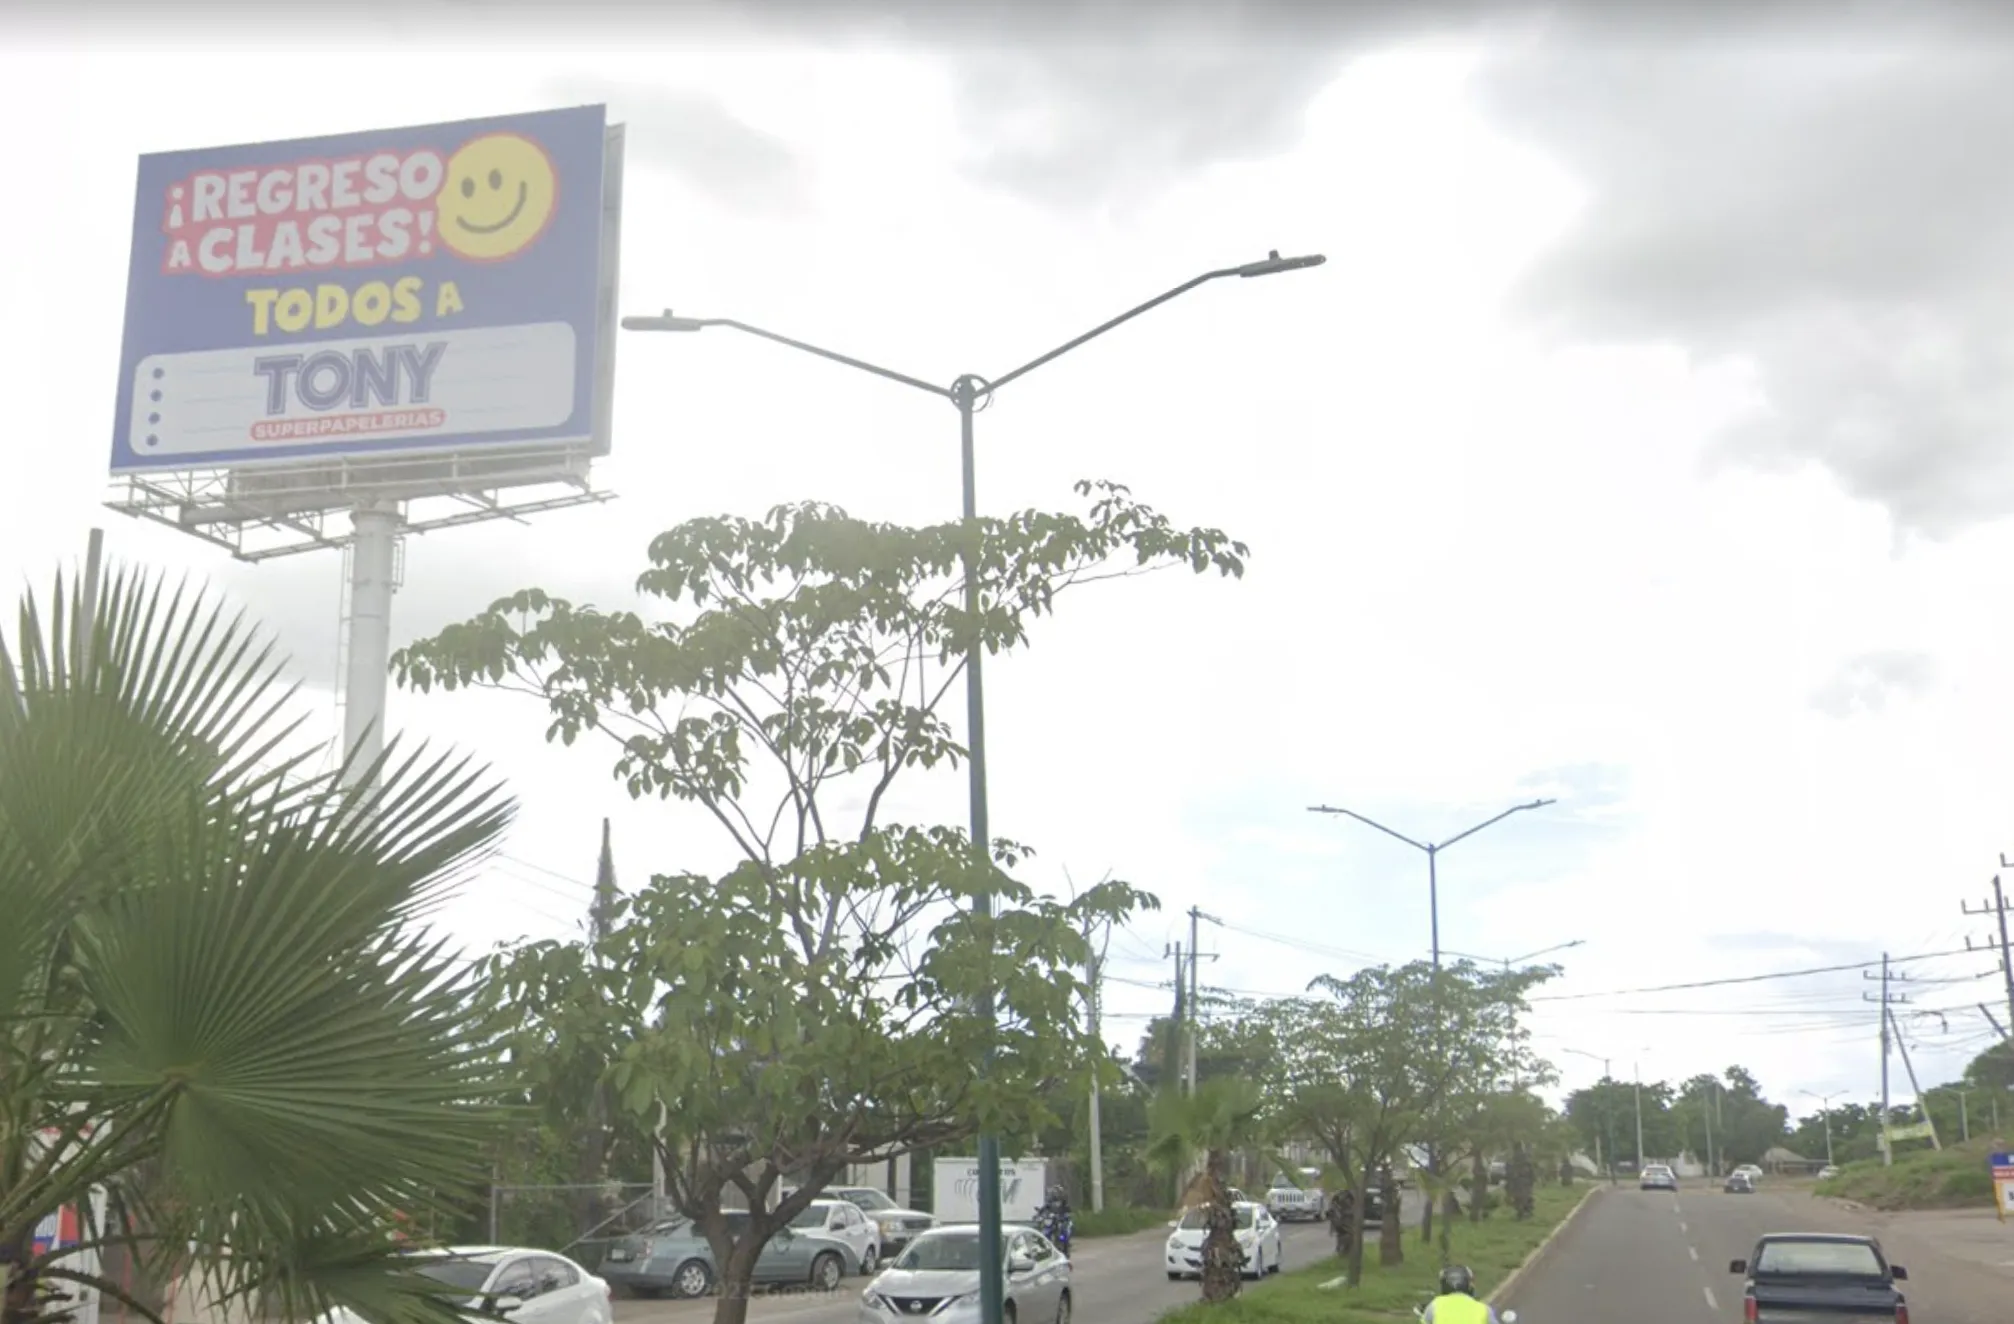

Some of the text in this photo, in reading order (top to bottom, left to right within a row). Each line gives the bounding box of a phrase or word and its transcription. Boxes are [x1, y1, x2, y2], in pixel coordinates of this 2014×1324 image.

[168, 152, 444, 228] ¡REGRESO
[168, 208, 435, 273] A CLASES!
[246, 276, 465, 335] TODOS A
[253, 341, 449, 416] TONY
[255, 411, 442, 438] SUPERPAPELERIAS
